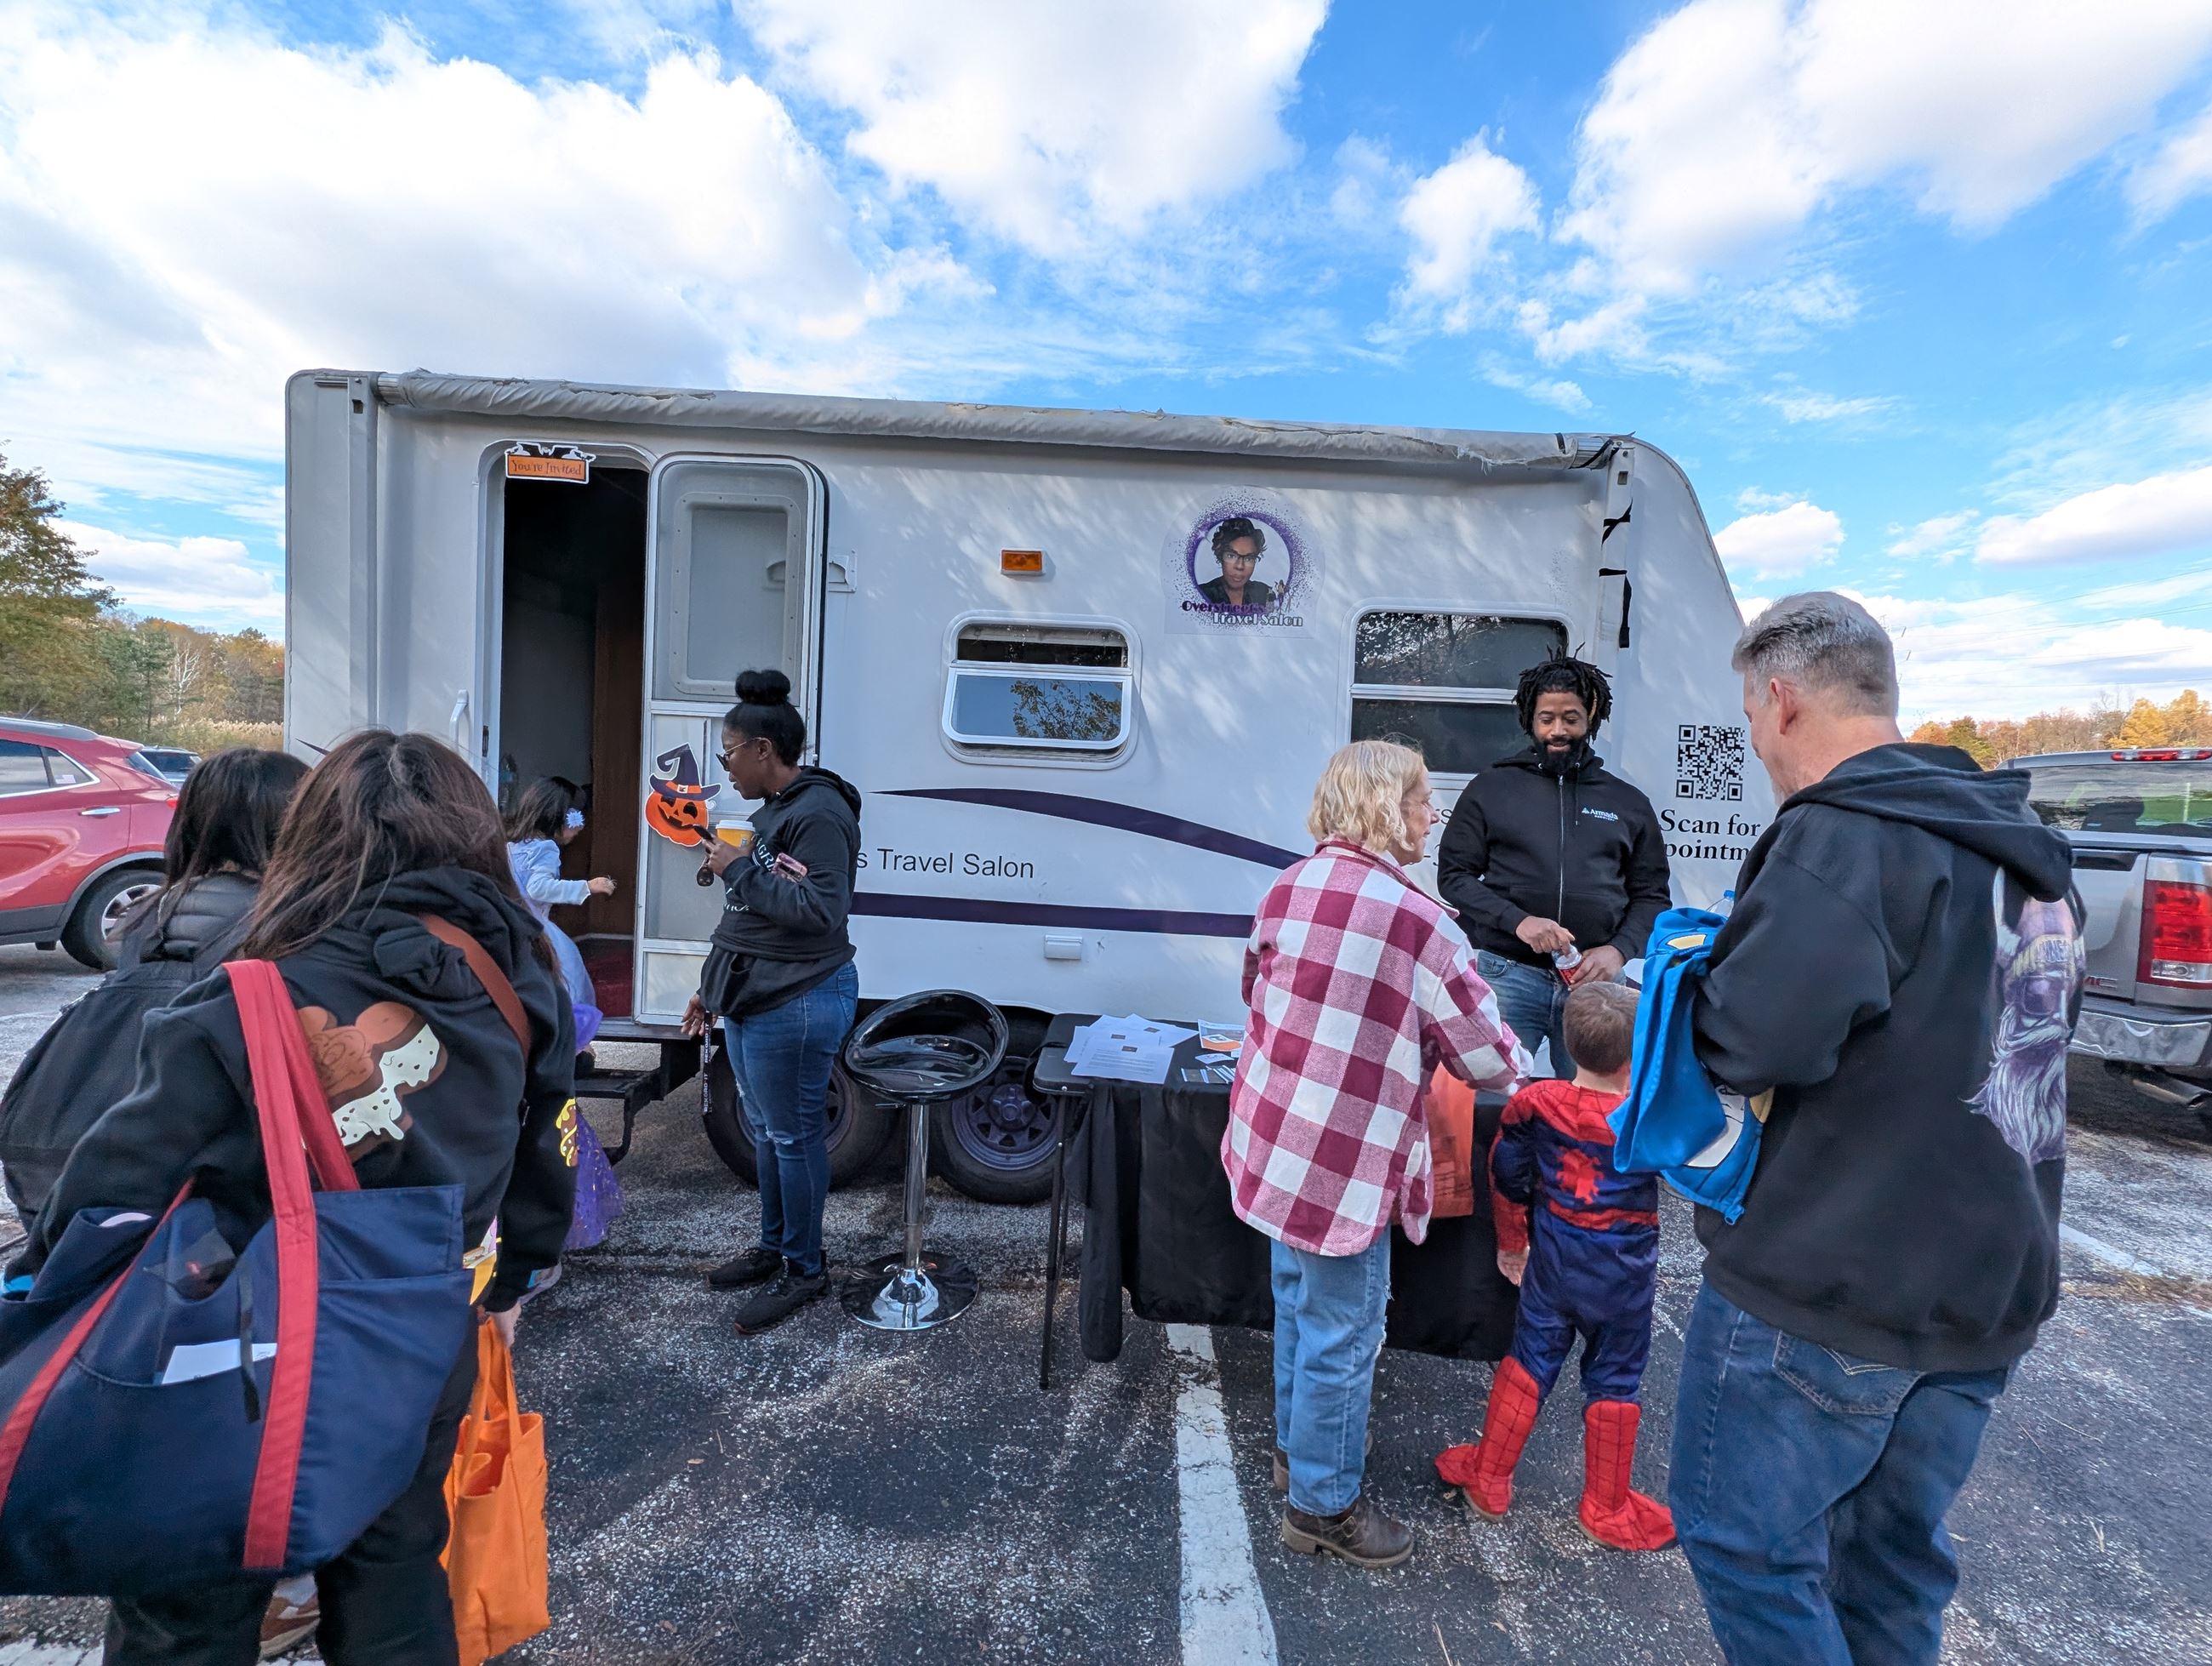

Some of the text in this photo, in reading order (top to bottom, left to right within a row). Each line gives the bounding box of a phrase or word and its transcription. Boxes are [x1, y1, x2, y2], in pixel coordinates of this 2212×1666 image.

[511, 459, 583, 476] You're Invited
[1212, 613, 1303, 627] Travel Salon
[1590, 808, 1618, 820] Armada
[1660, 809, 1761, 836] Scan for
[1664, 839, 1749, 861] pointm
[877, 847, 954, 874] Travel
[963, 853, 1034, 878] Salon
